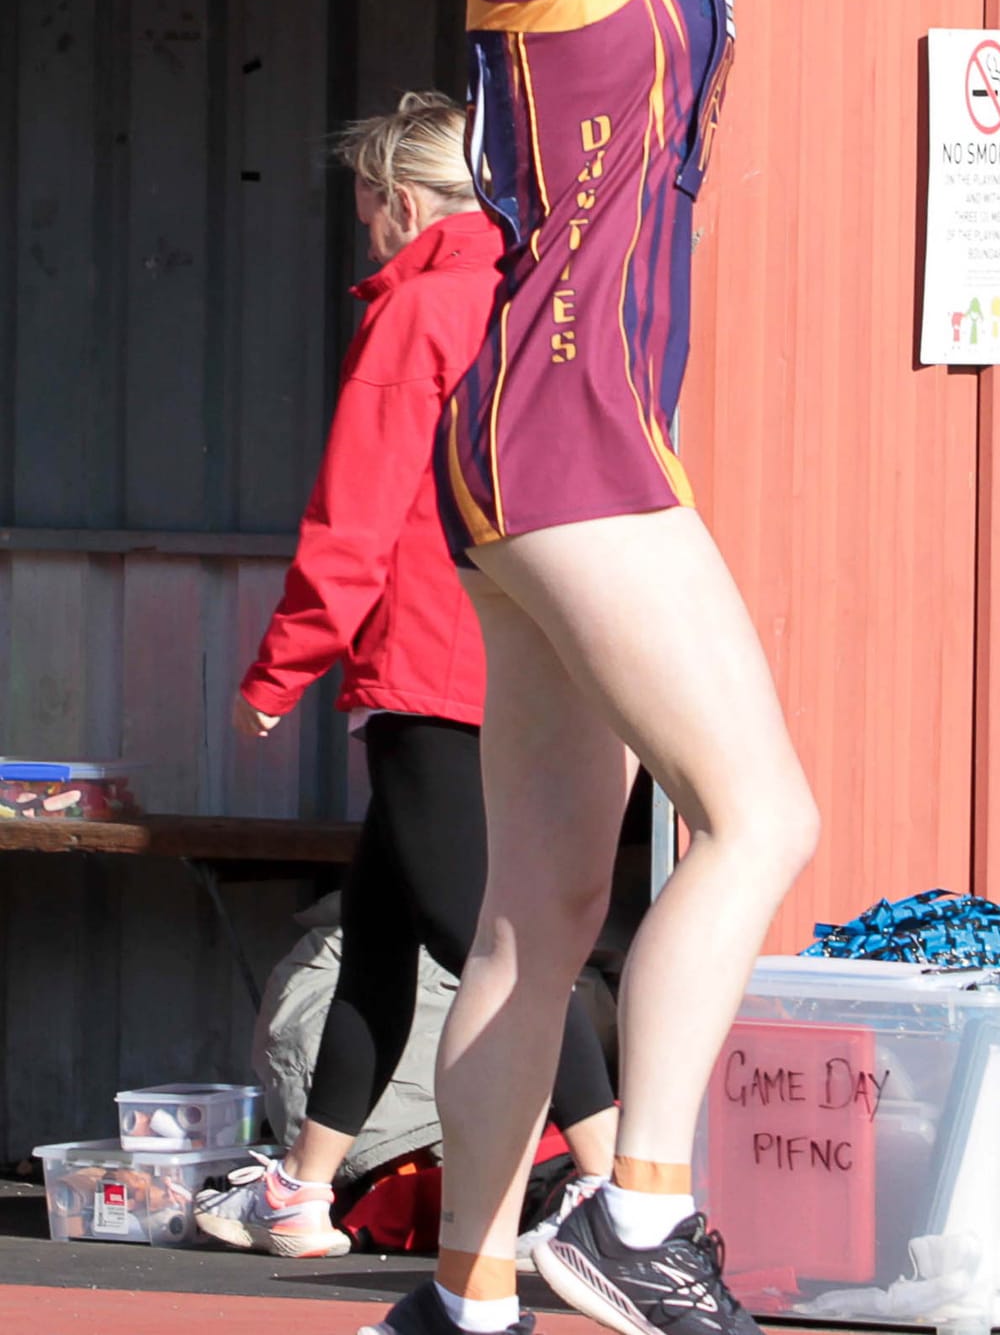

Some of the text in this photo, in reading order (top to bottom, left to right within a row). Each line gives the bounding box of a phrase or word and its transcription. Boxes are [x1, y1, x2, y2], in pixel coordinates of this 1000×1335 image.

[942, 142, 962, 166] NO
[965, 192, 981, 204] AND
[725, 1050, 891, 1123] GAME DAY
[753, 1132, 853, 1172] PIFNC
